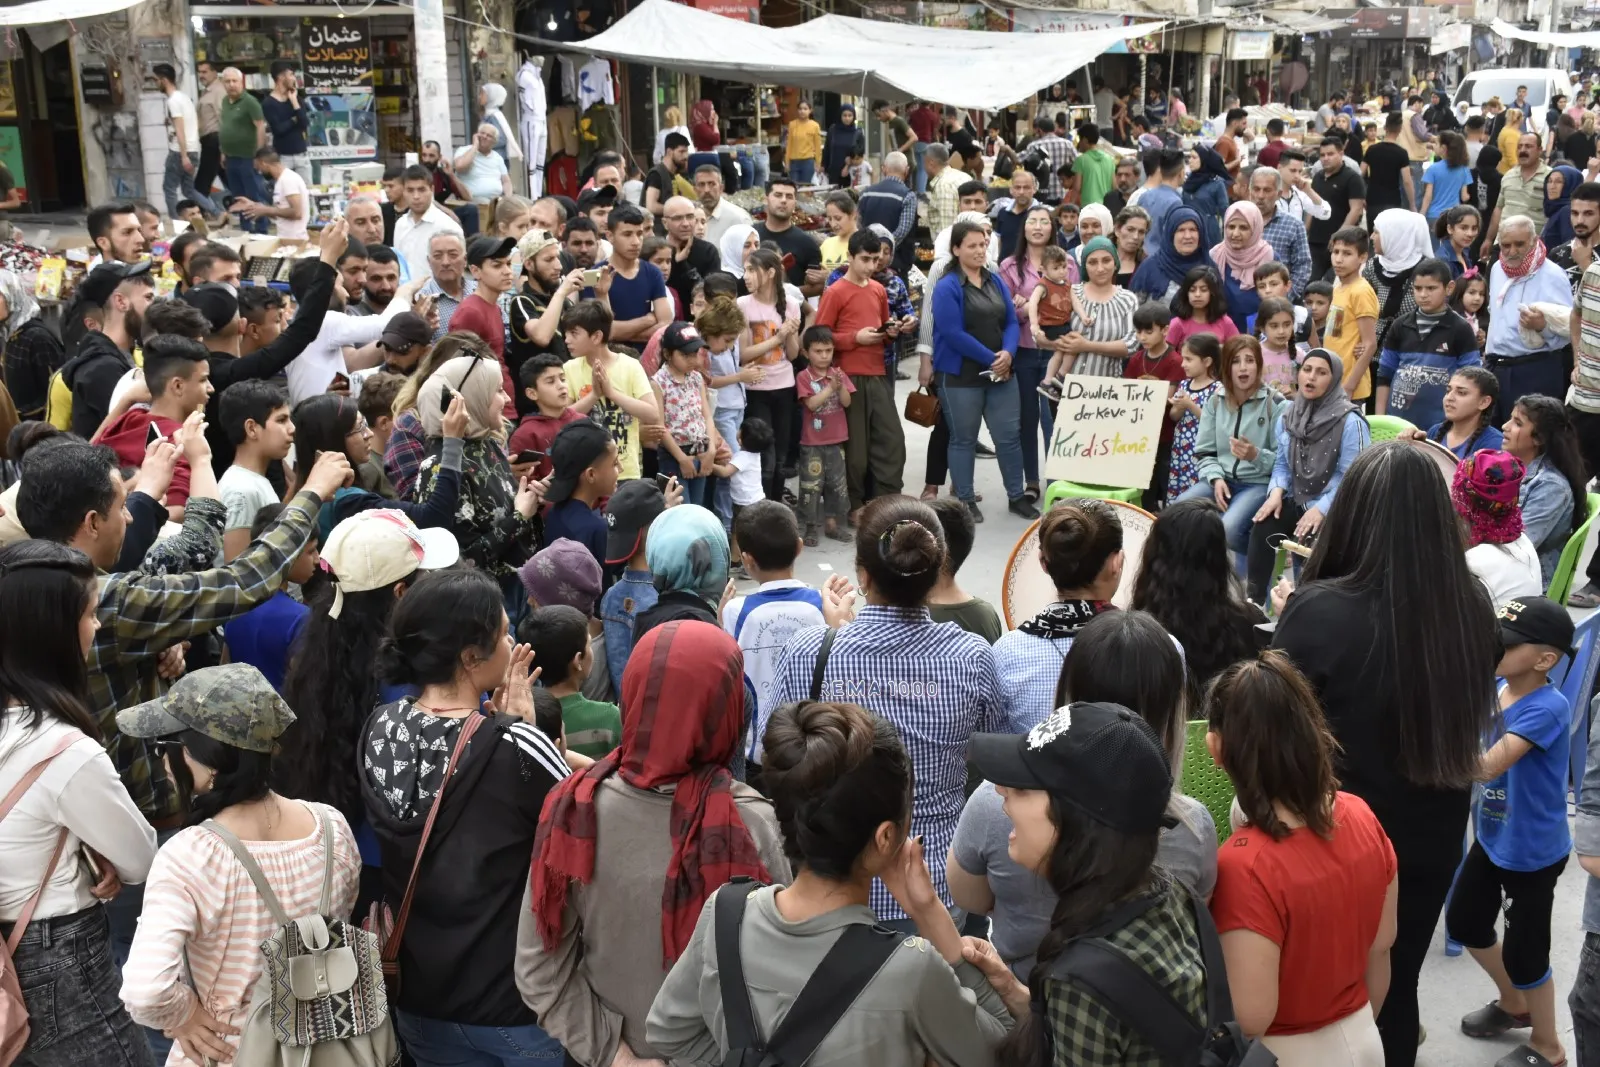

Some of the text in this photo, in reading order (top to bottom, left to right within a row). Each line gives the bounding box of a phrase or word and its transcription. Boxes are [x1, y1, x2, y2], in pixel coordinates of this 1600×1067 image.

[309, 24, 362, 47] عثمان
[1067, 382, 1155, 402] Dewleta Tirk
[820, 680, 939, 697] REMA 1000
